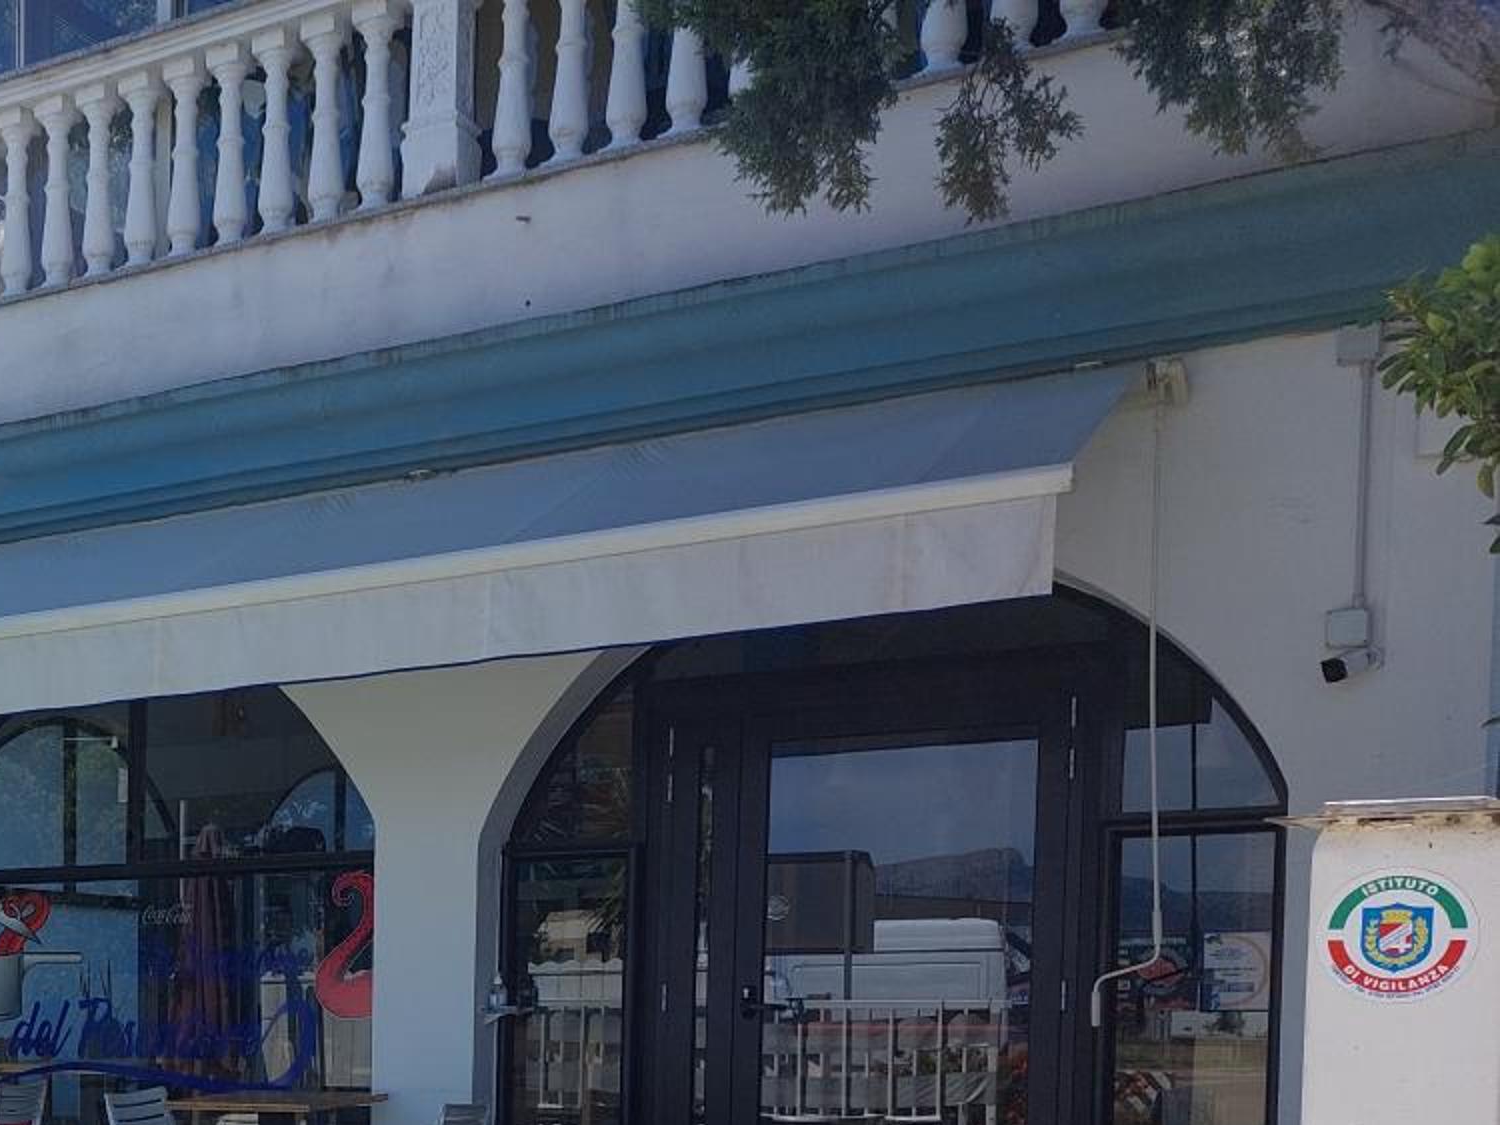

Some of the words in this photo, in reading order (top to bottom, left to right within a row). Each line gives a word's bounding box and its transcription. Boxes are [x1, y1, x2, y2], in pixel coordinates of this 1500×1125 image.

[1361, 877, 1438, 897] ISTITUTO
[1343, 964, 1361, 979] DI
[1363, 965, 1449, 991] VIGILANZA
[8, 1000, 72, 1058] del
